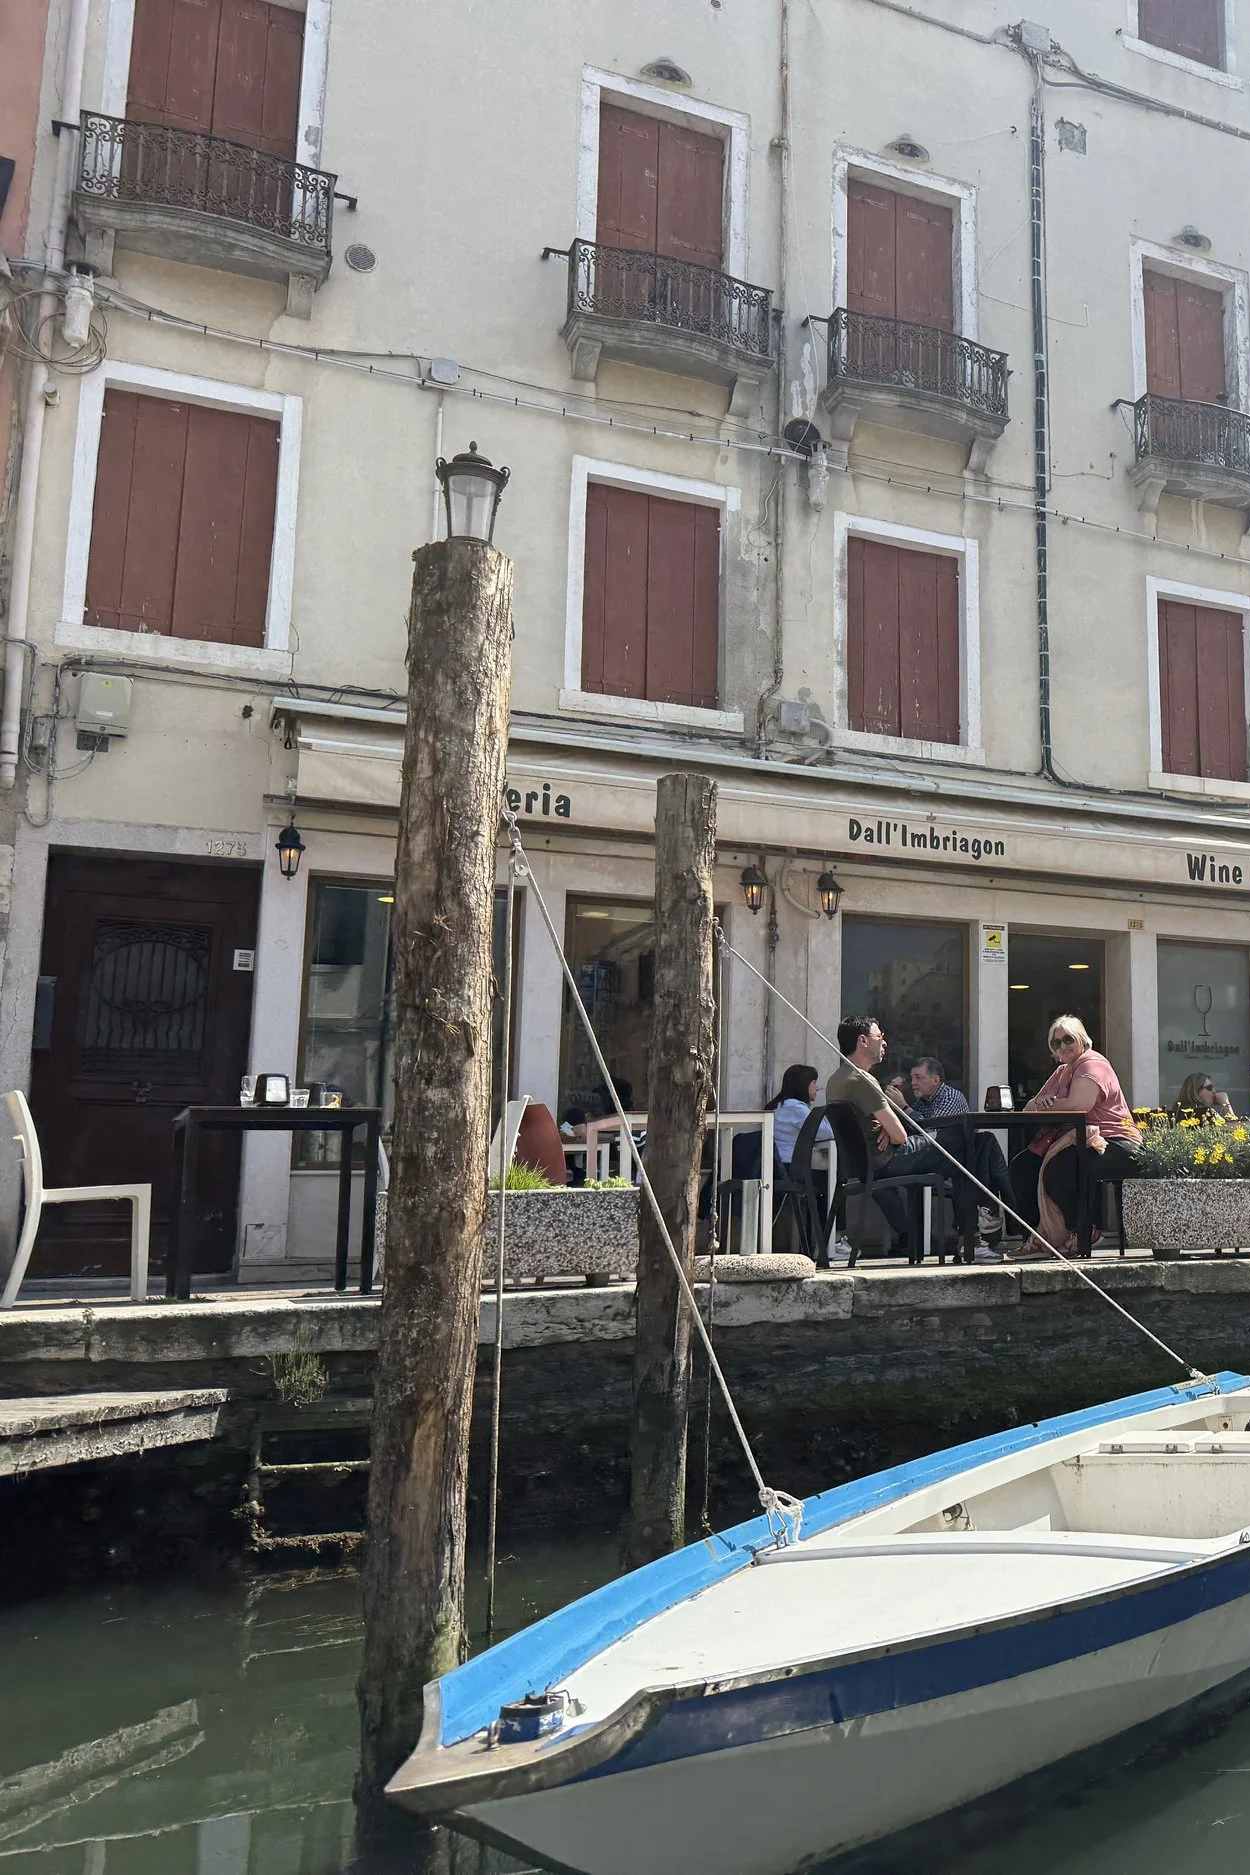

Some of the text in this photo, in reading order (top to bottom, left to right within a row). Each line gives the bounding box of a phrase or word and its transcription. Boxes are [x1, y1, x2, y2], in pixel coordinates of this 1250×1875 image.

[505, 782, 572, 819] eria
[848, 818, 1006, 861] Dall'Imbriagon
[1186, 853, 1243, 885] Wine
